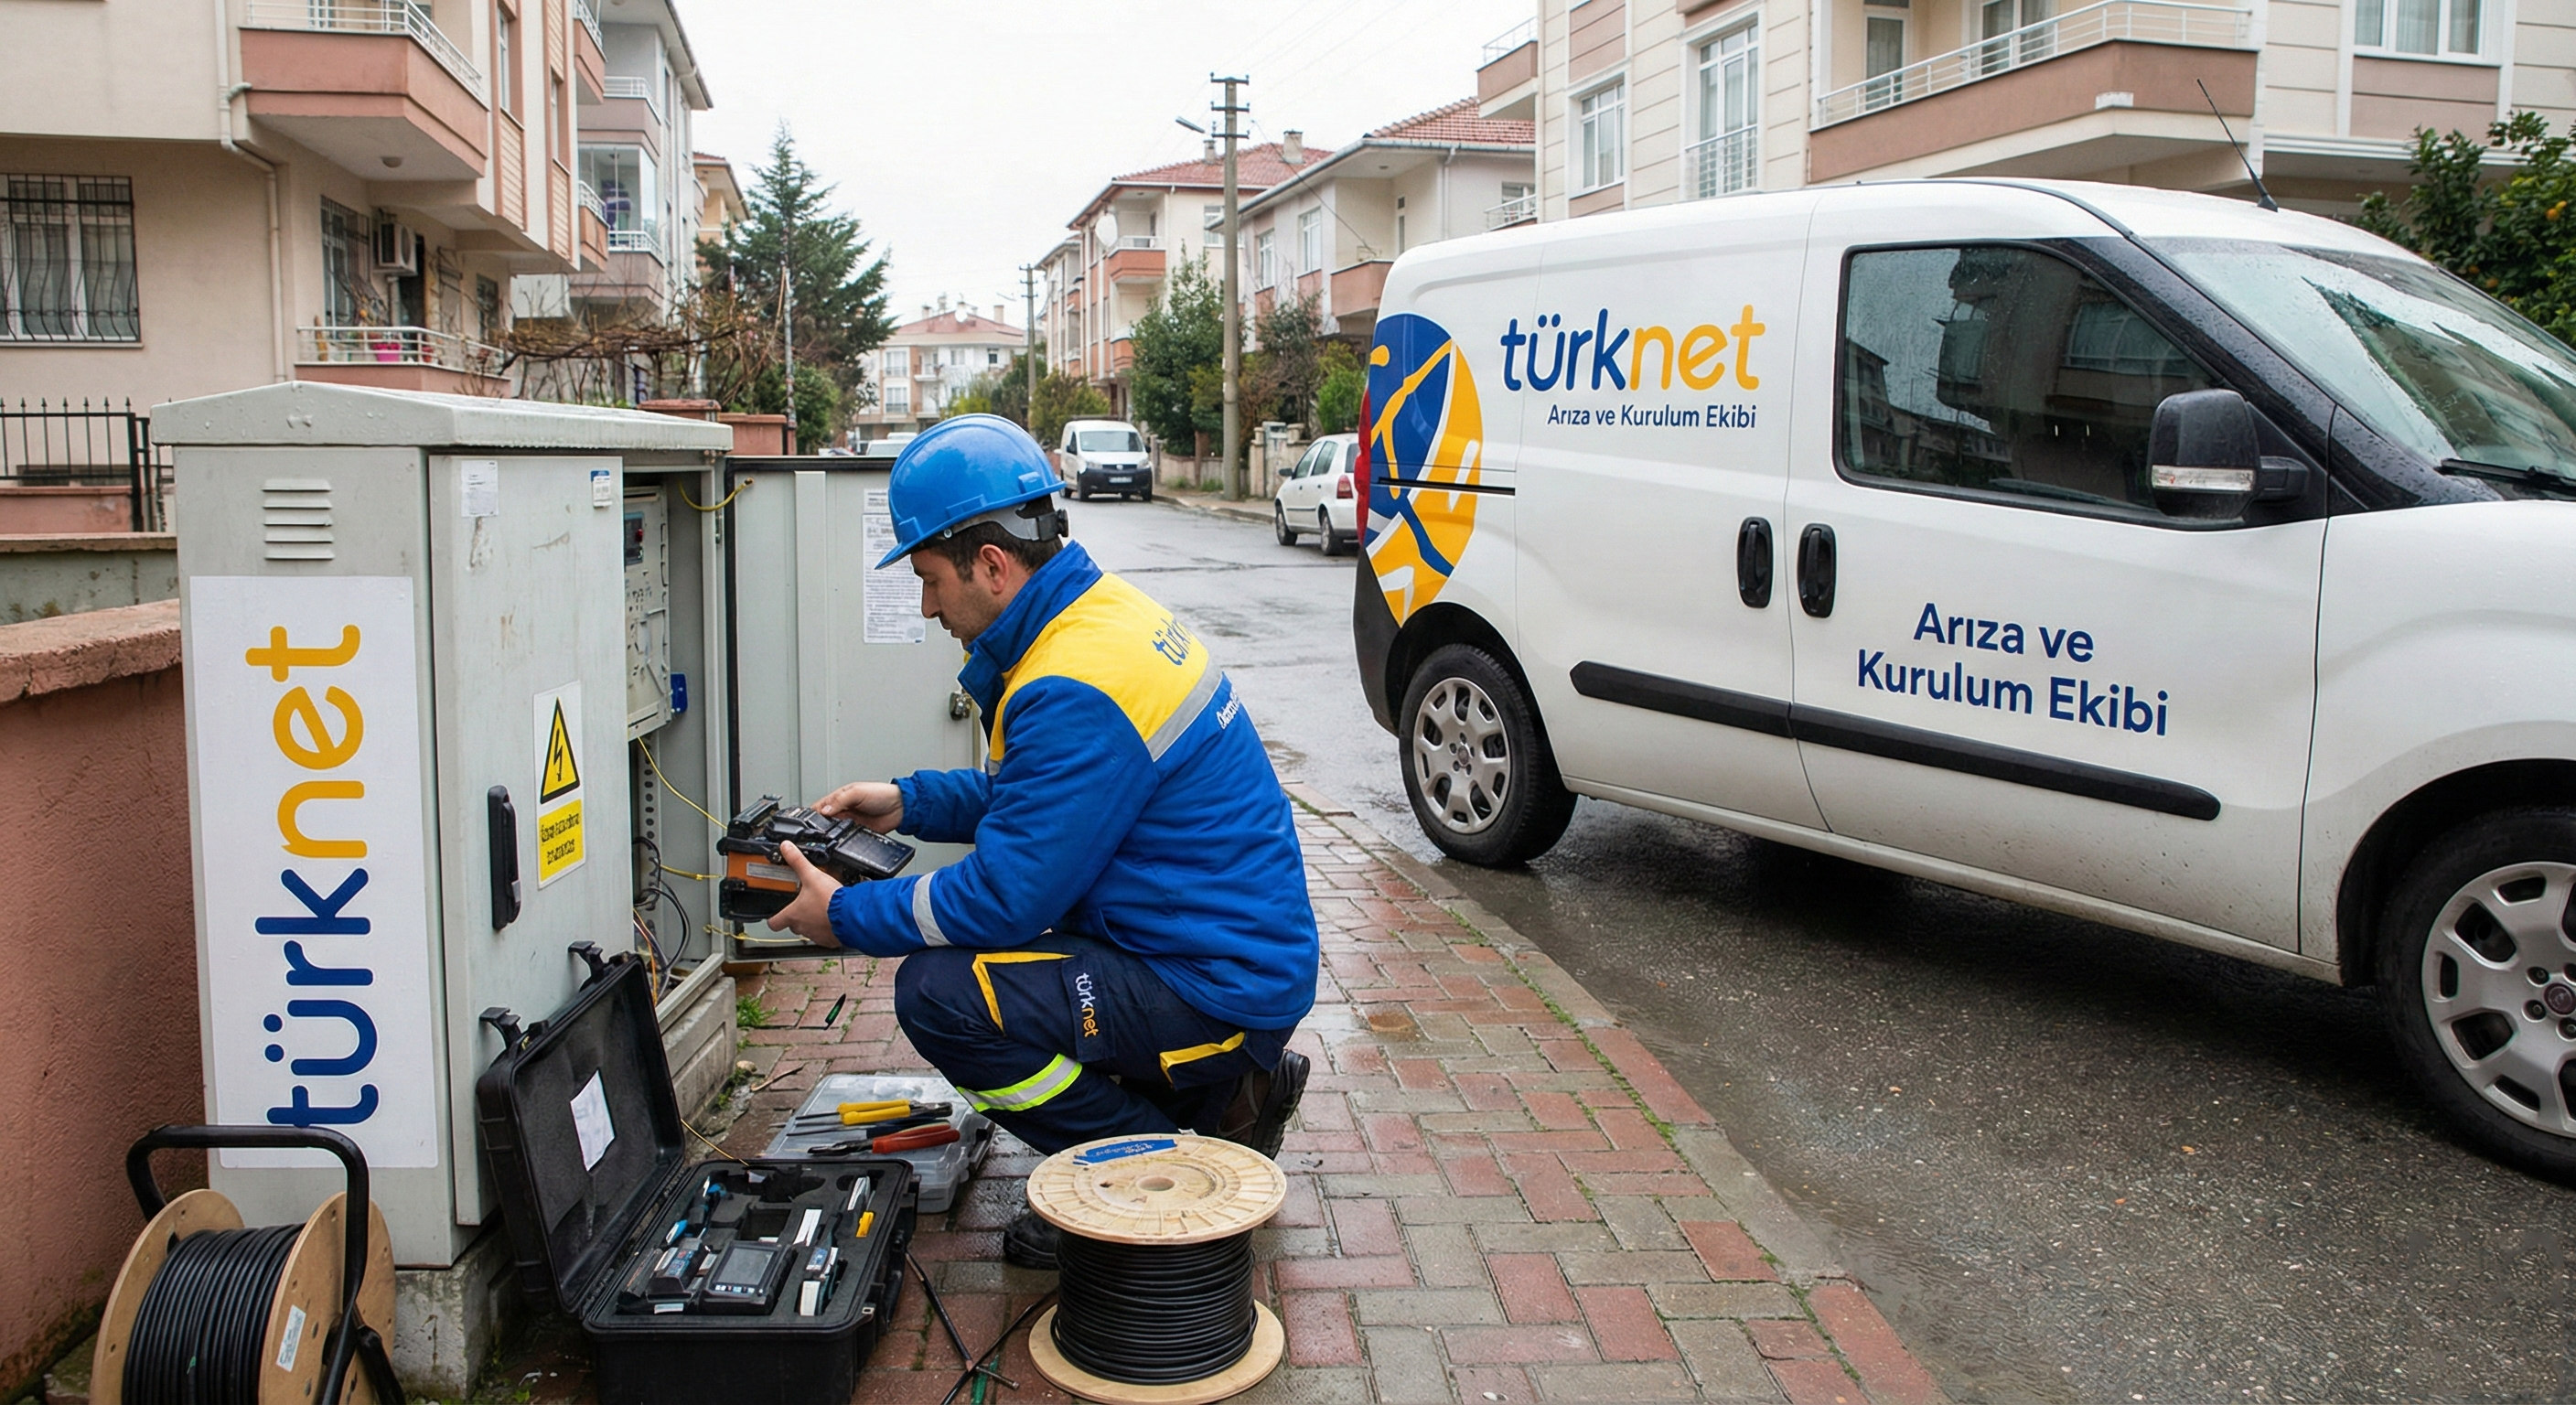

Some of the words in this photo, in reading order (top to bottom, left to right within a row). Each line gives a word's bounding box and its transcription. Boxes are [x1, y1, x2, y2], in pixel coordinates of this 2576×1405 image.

[1499, 304, 1766, 391] türknet
[1547, 403, 1591, 425] Arıza
[1595, 410, 1615, 426] ve
[1621, 403, 1700, 427] Kurulum
[1706, 403, 1757, 428] Ekibi
[1913, 602, 2024, 655] Arıza
[2038, 627, 2094, 663] ve
[1857, 649, 2033, 715] Kurulum
[2049, 676, 2169, 736] Ekibi
[244, 624, 379, 1128] türknet
[1075, 972, 1100, 1038] türknet
